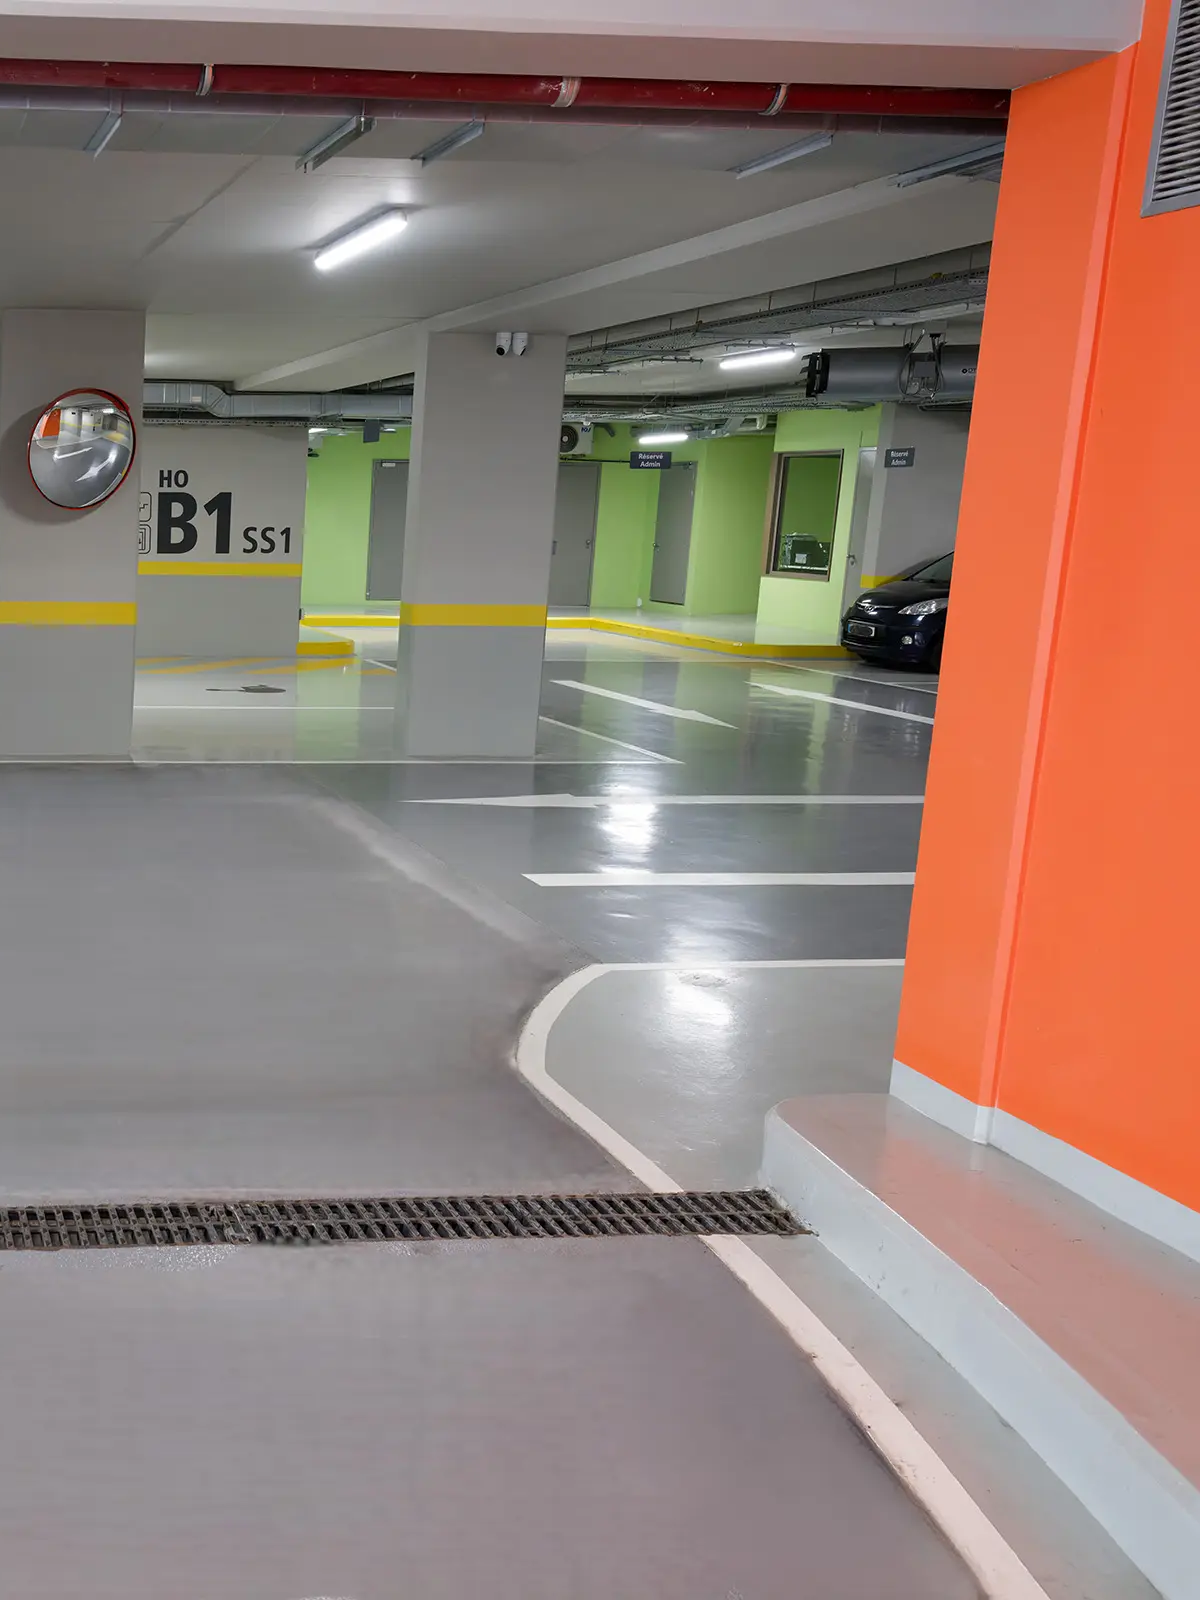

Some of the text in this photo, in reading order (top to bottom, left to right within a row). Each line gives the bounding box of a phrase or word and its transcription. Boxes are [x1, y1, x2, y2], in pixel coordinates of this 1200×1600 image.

[159, 469, 189, 488] HO
[156, 491, 291, 555] B1 SS1
